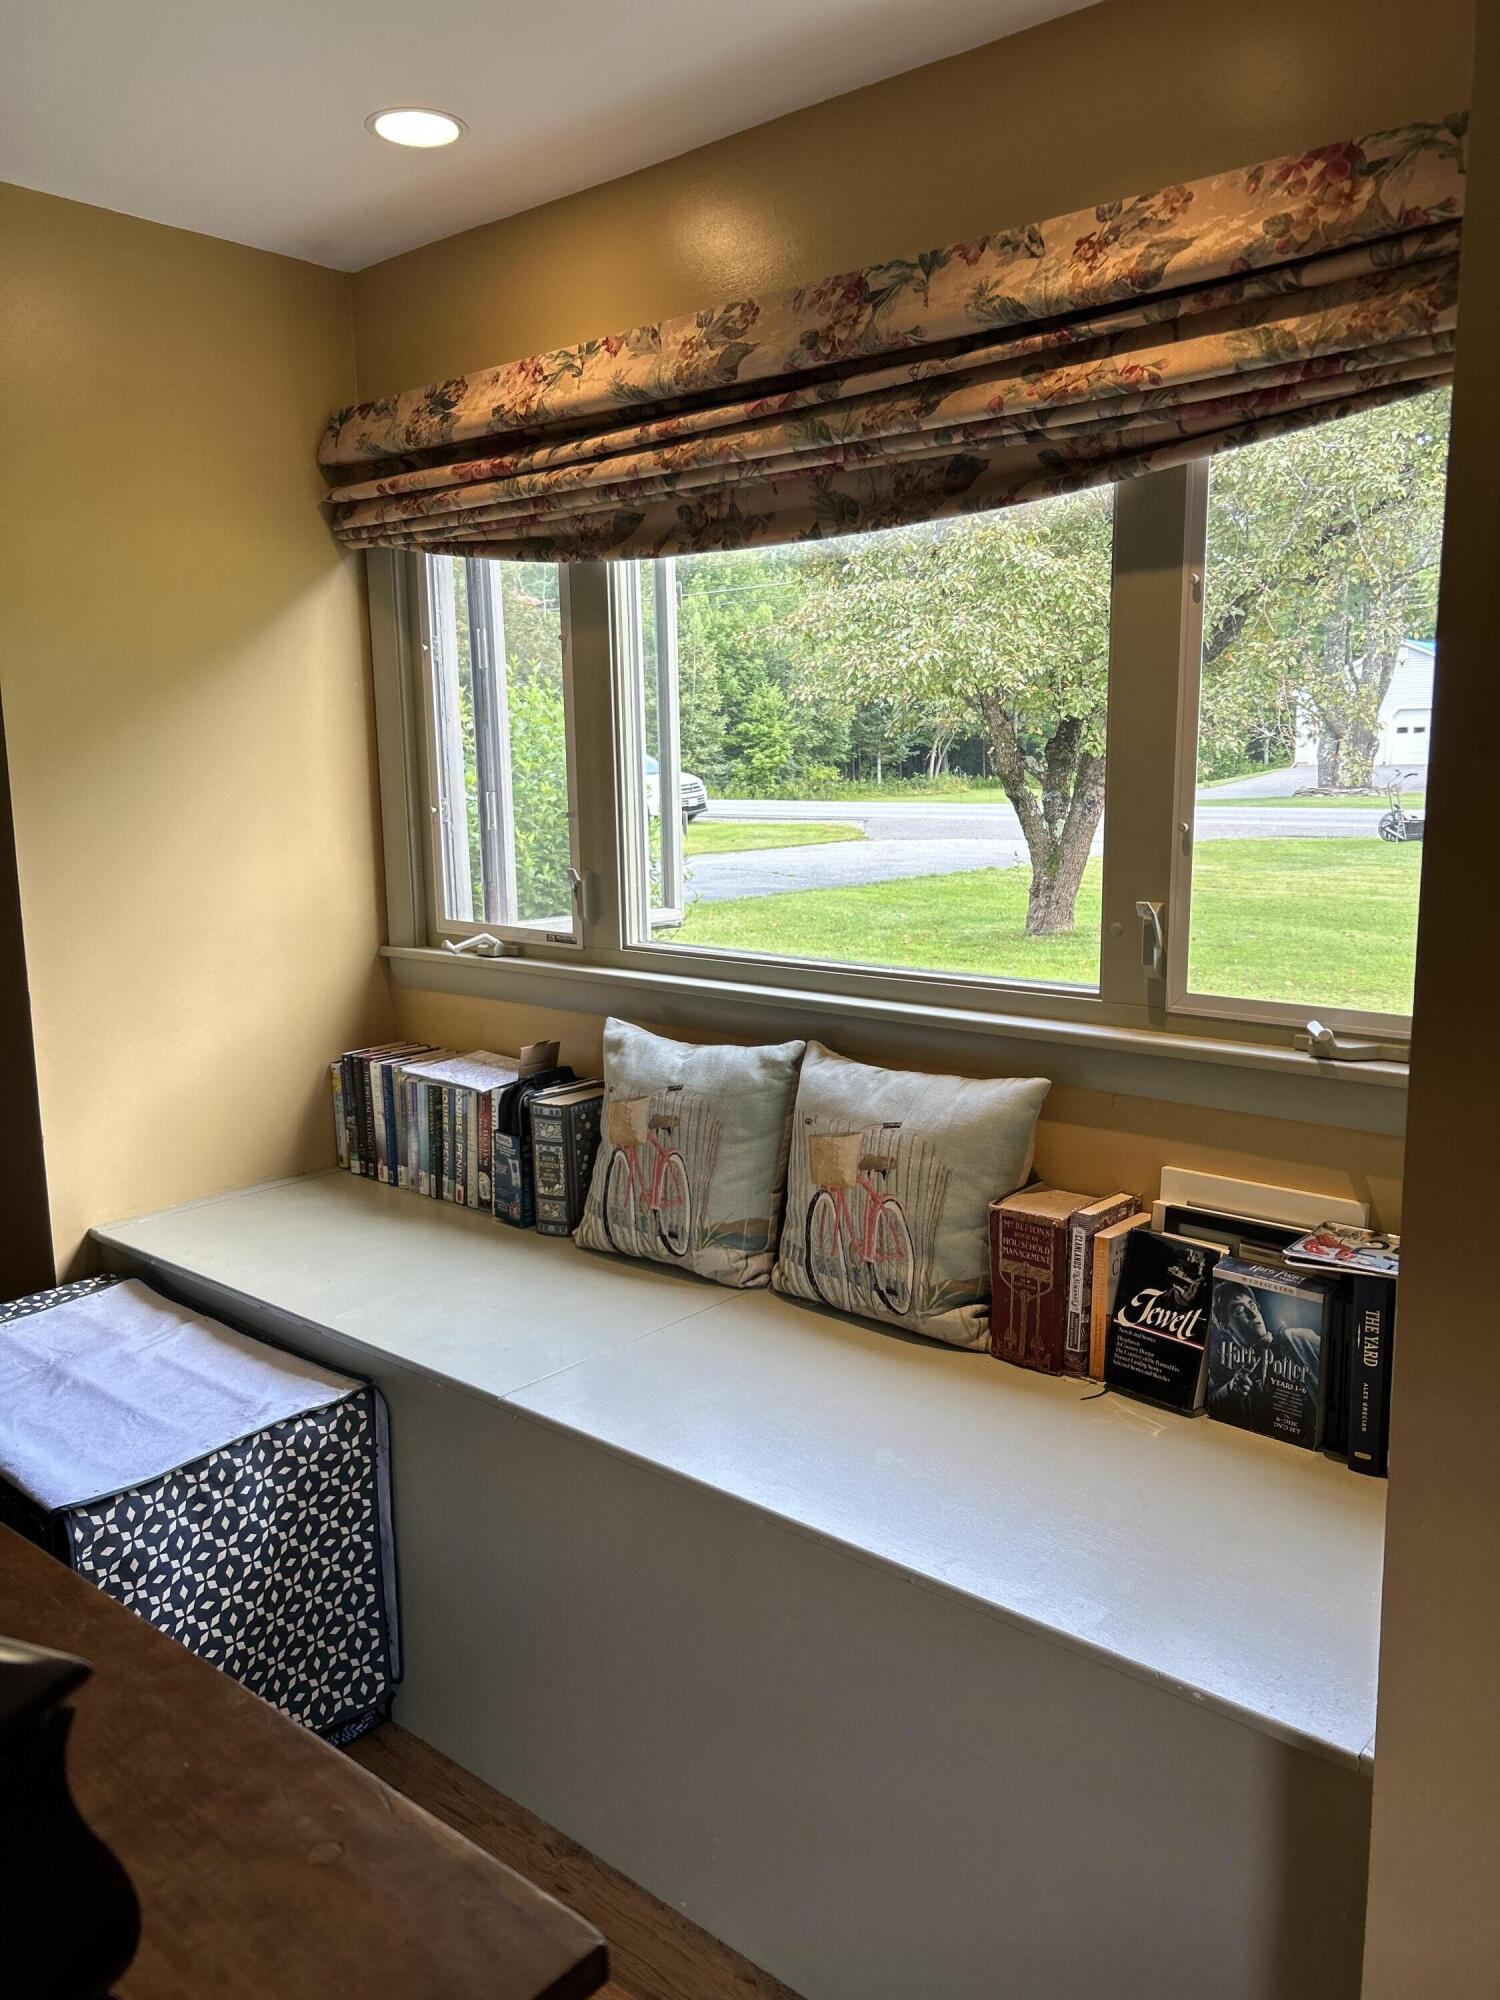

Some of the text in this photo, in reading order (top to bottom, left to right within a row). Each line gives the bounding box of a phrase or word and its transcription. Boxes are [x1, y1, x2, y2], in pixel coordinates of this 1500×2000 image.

[442, 1141, 450, 1177] PENN
[456, 1144, 464, 1184] PENNY
[1002, 1246, 1050, 1264] MANAGEMENT
[1003, 1236, 1050, 1255] HOUSEHOLD
[1073, 1235, 1084, 1270] CLANLANDS
[1364, 1310, 1380, 1368] THE YARD
[1220, 1341, 1310, 1387] Harry Potter
[1270, 1378, 1294, 1390] YEARS
[1274, 1422, 1302, 1434] DVD SET
